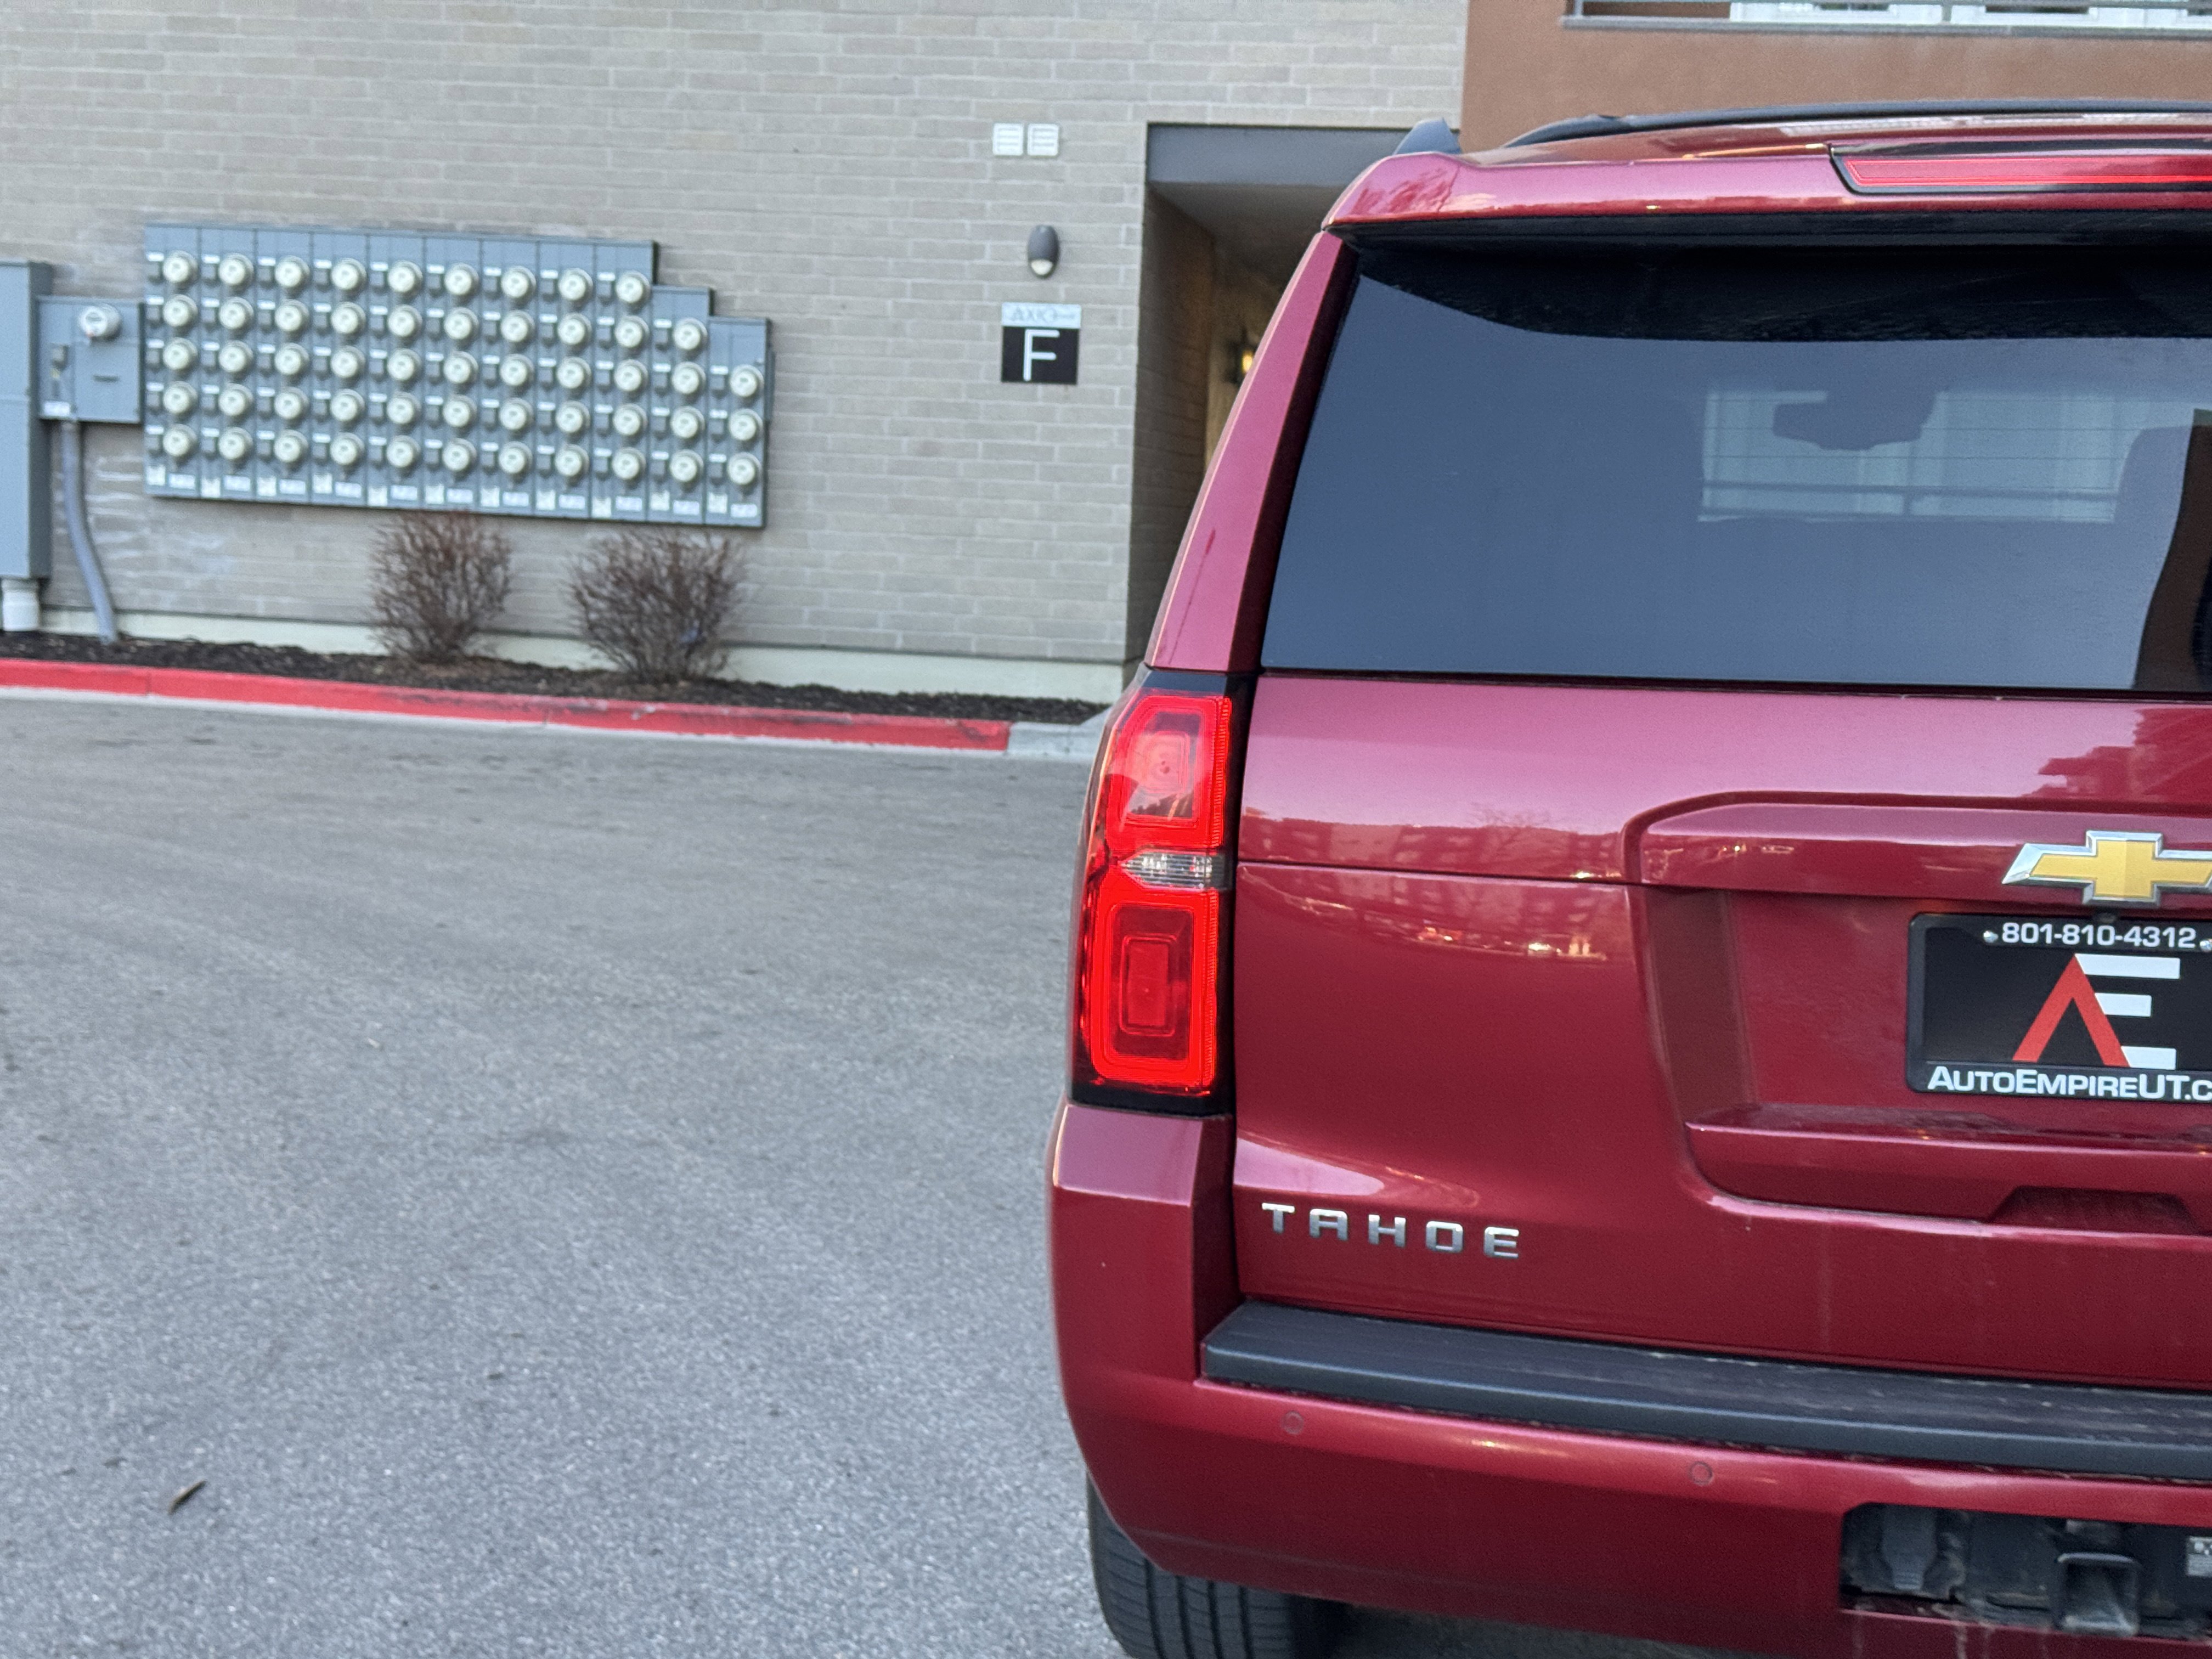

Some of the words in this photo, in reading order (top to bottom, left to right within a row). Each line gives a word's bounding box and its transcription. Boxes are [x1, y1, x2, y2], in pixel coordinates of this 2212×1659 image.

[1023, 329, 1060, 381] F
[2002, 922, 2196, 948] 801-810-4312
[1261, 1203, 1520, 1259] TAHOE
